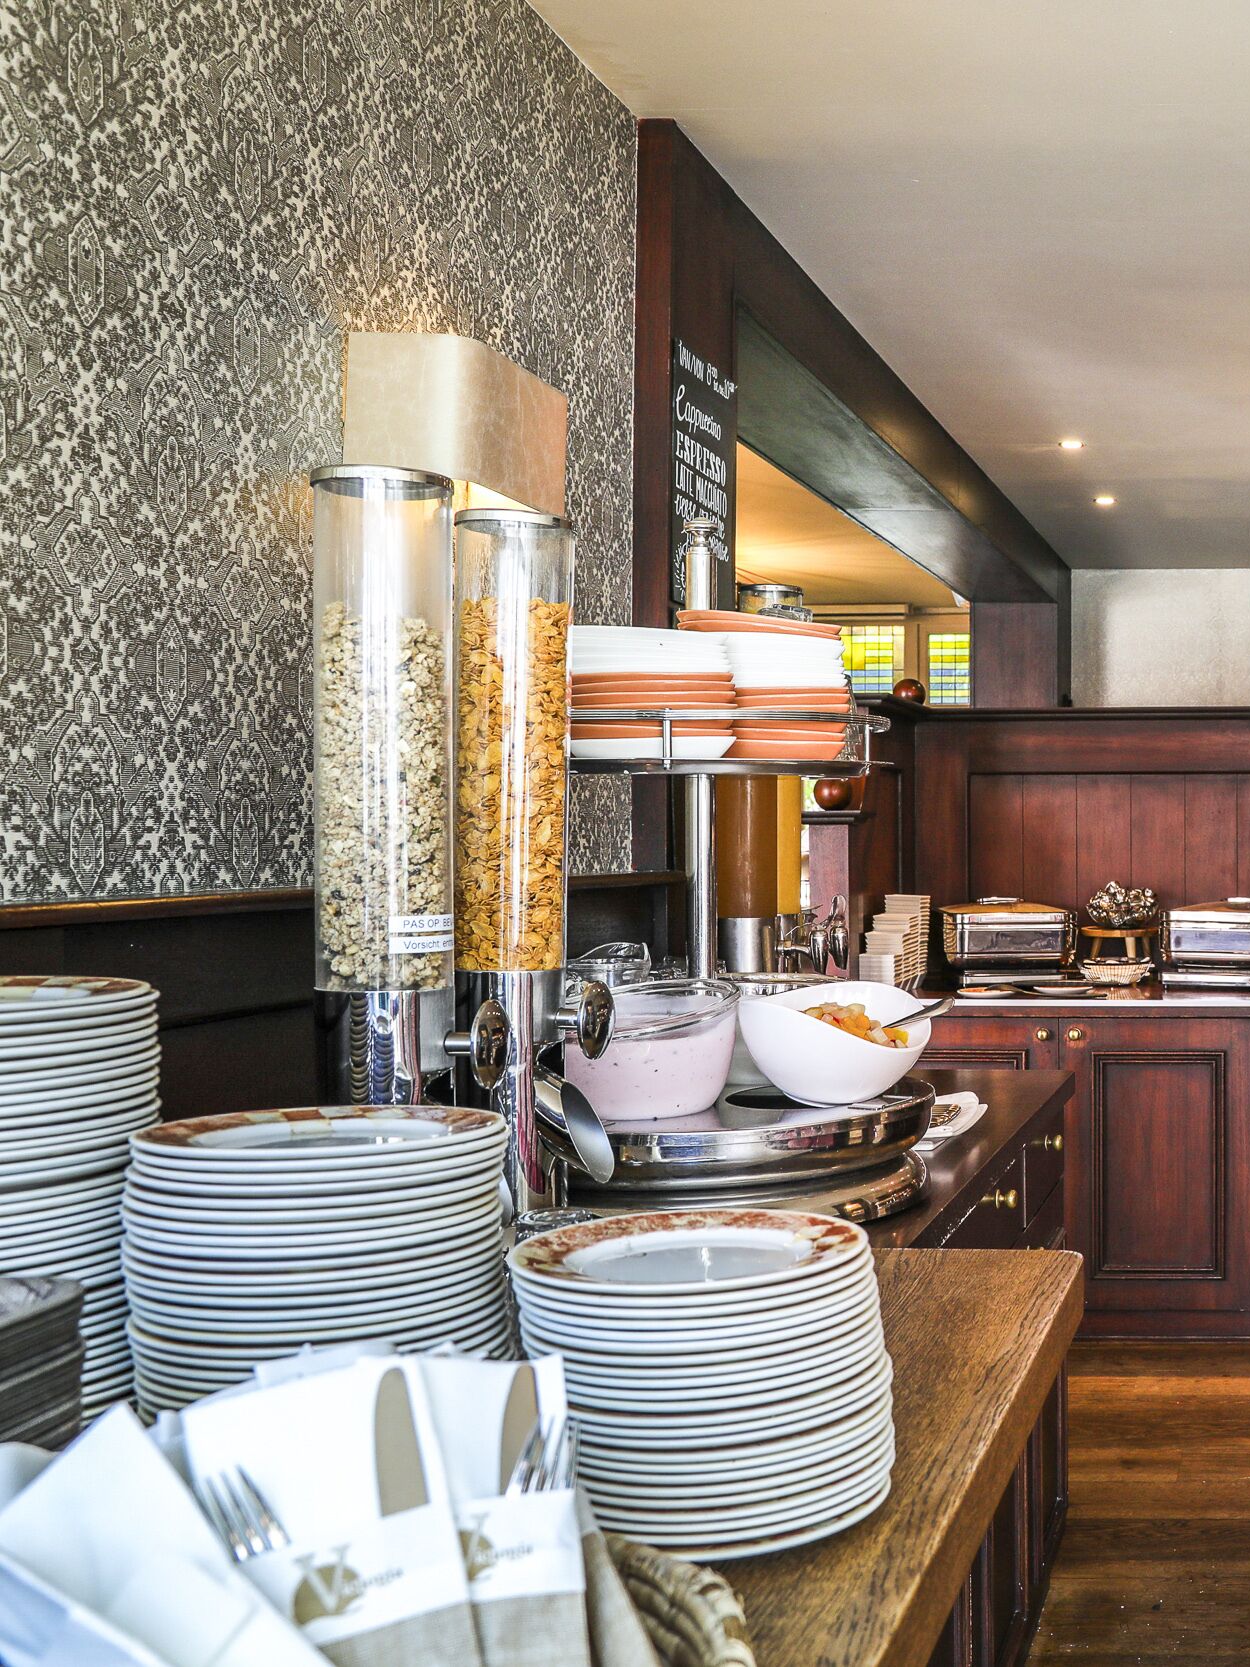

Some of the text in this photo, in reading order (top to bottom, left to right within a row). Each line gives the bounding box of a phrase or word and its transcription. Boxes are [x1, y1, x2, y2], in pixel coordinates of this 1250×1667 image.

[675, 429, 727, 487] ESPRESSO
[675, 460, 728, 519] LATTE MACCHIATO
[403, 919, 425, 929] PAS
[427, 918, 440, 928] OP
[404, 940, 440, 950] Vorsicht
